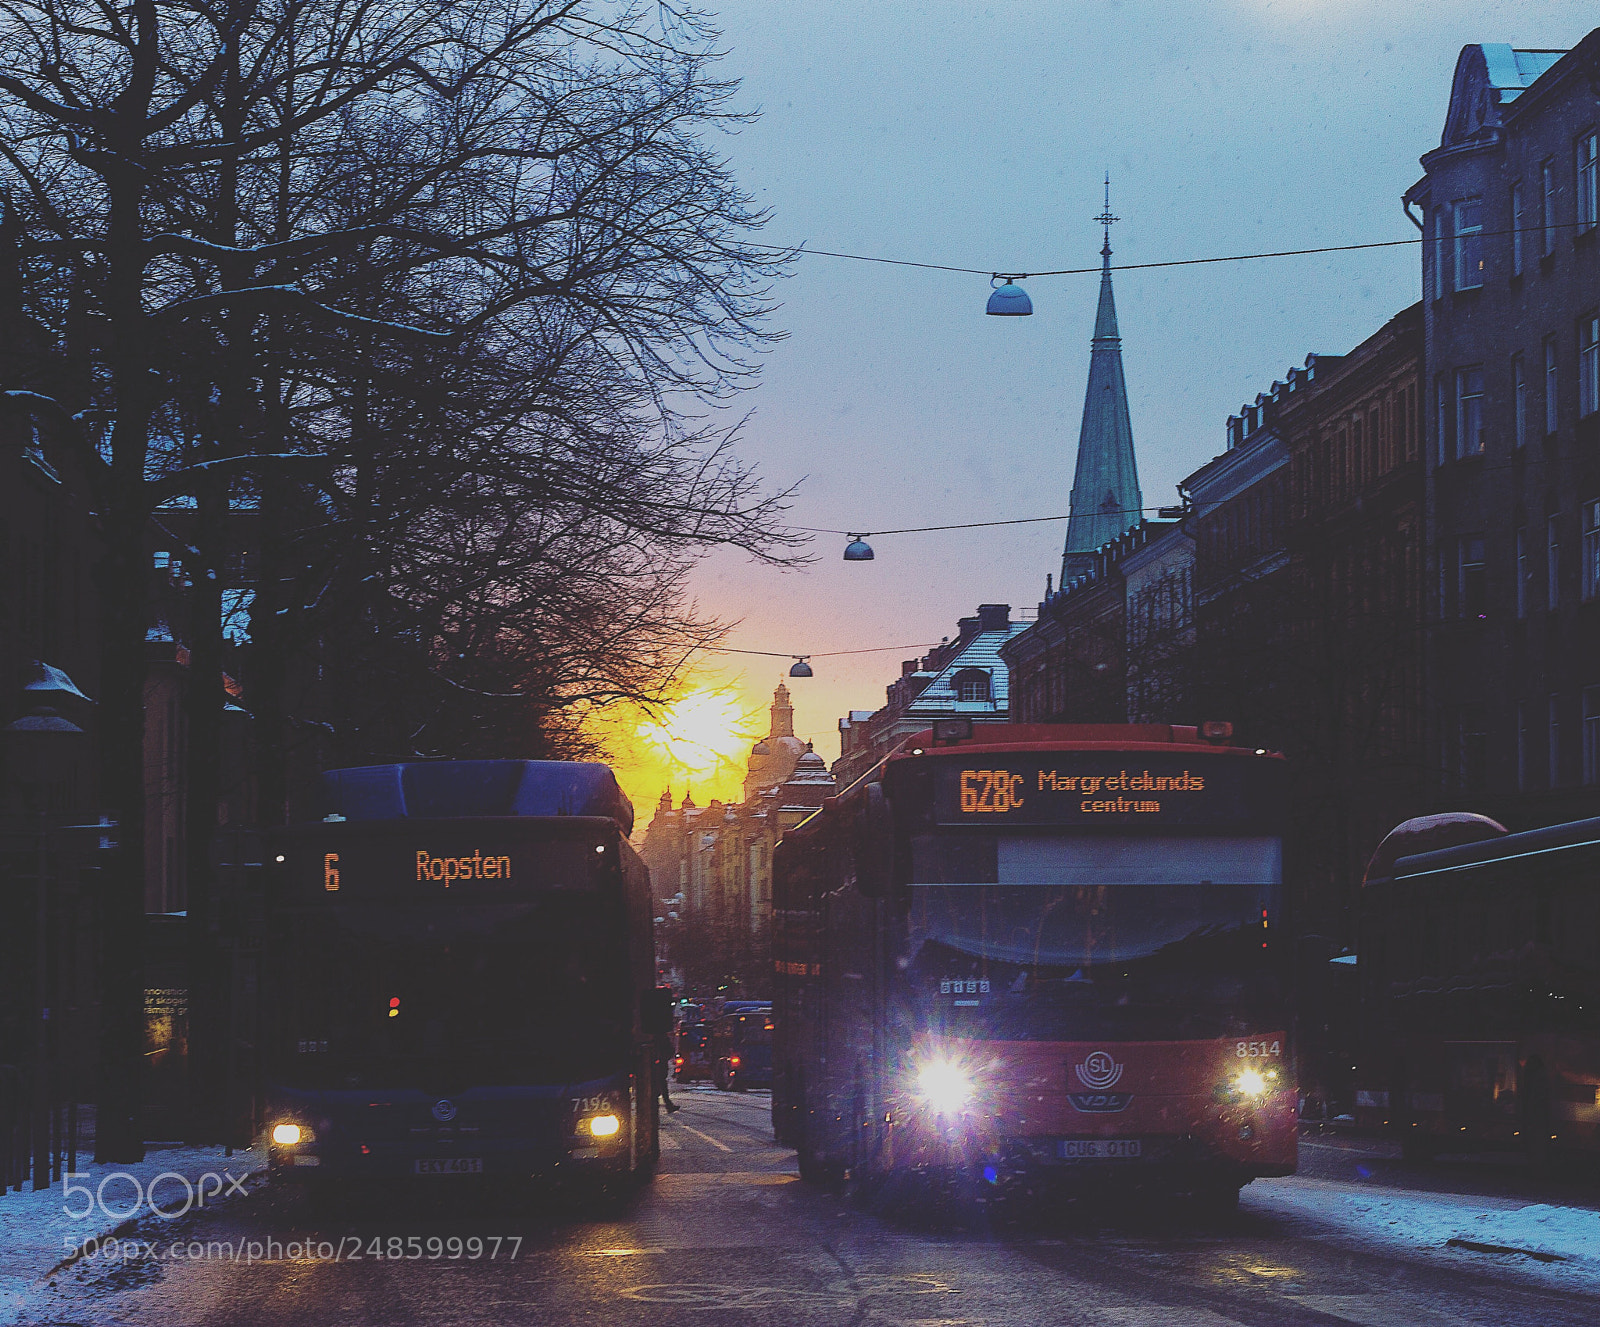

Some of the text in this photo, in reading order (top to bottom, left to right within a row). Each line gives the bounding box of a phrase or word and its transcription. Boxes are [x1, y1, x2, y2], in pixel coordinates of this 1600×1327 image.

[1038, 769, 1205, 795] Margretelunds
[1080, 796, 1160, 812] centrum
[324, 853, 340, 891] 6
[416, 849, 511, 888] Ropsten
[1236, 1041, 1281, 1058] 8514
[1089, 1058, 1110, 1073] SL
[571, 1097, 611, 1112] 7196
[1078, 1096, 1120, 1106] VDL
[1106, 1142, 1139, 1155] 010
